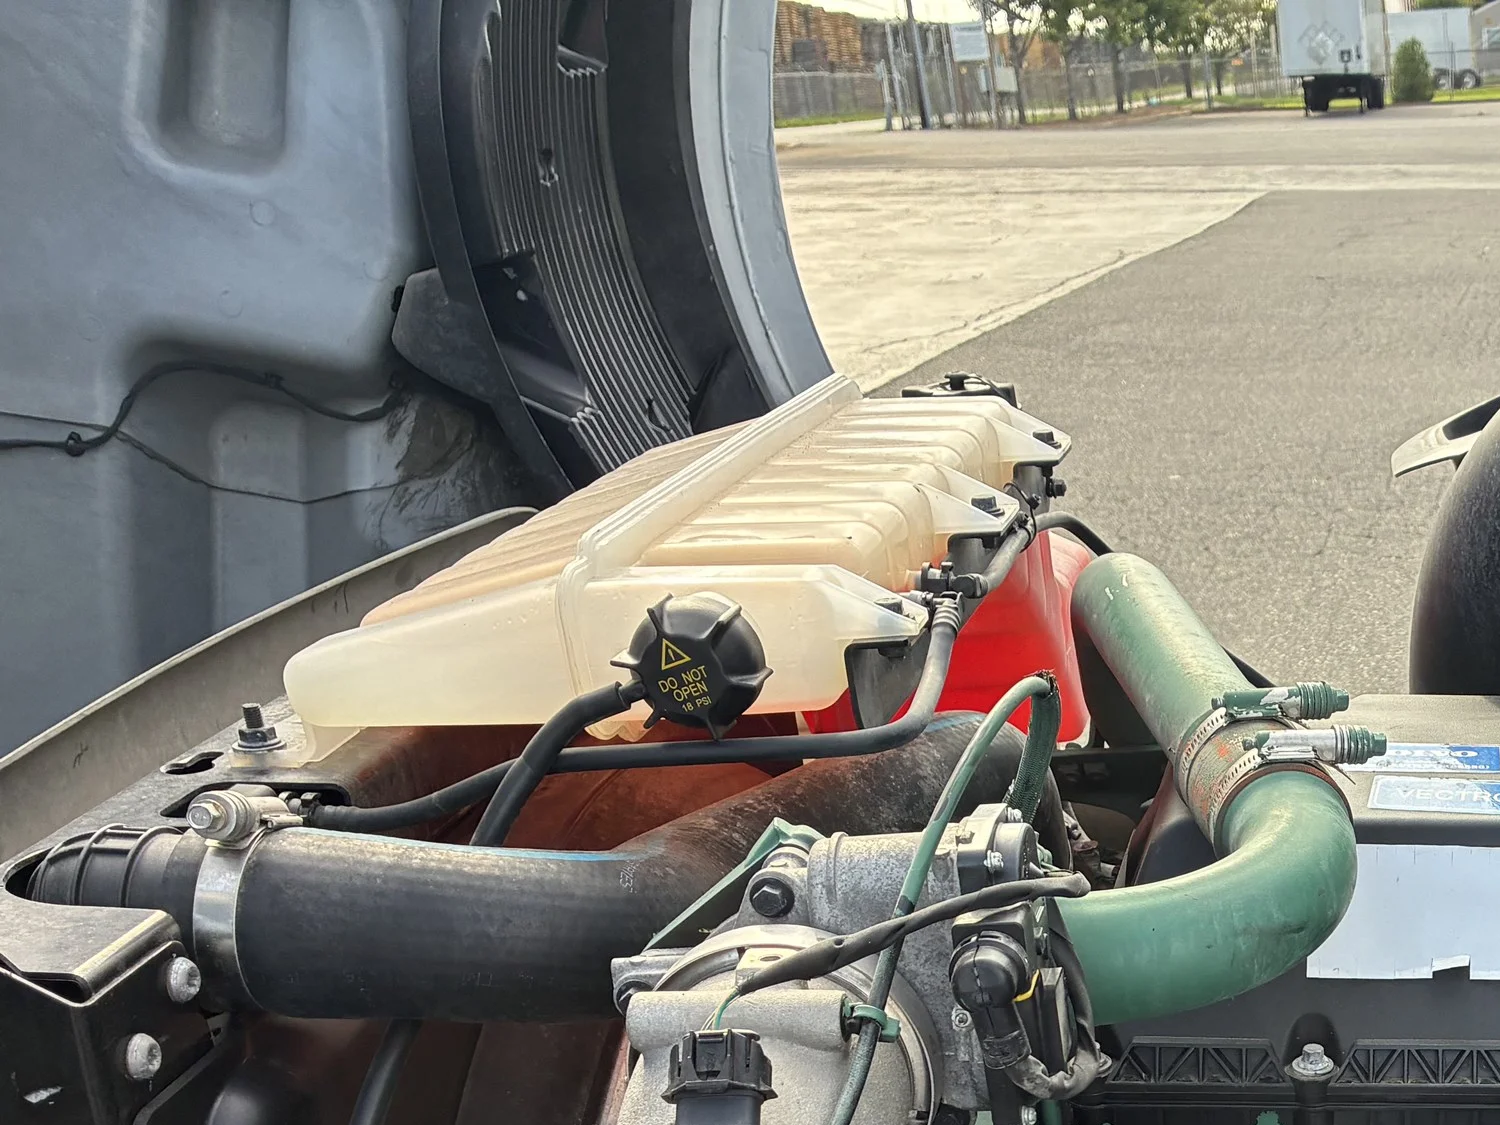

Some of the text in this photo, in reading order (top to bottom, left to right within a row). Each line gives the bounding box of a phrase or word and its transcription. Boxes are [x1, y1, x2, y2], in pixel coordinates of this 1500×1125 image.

[658, 665, 707, 693] DO NOT
[673, 681, 708, 702] OPEN
[682, 696, 712, 712] 18 PSI
